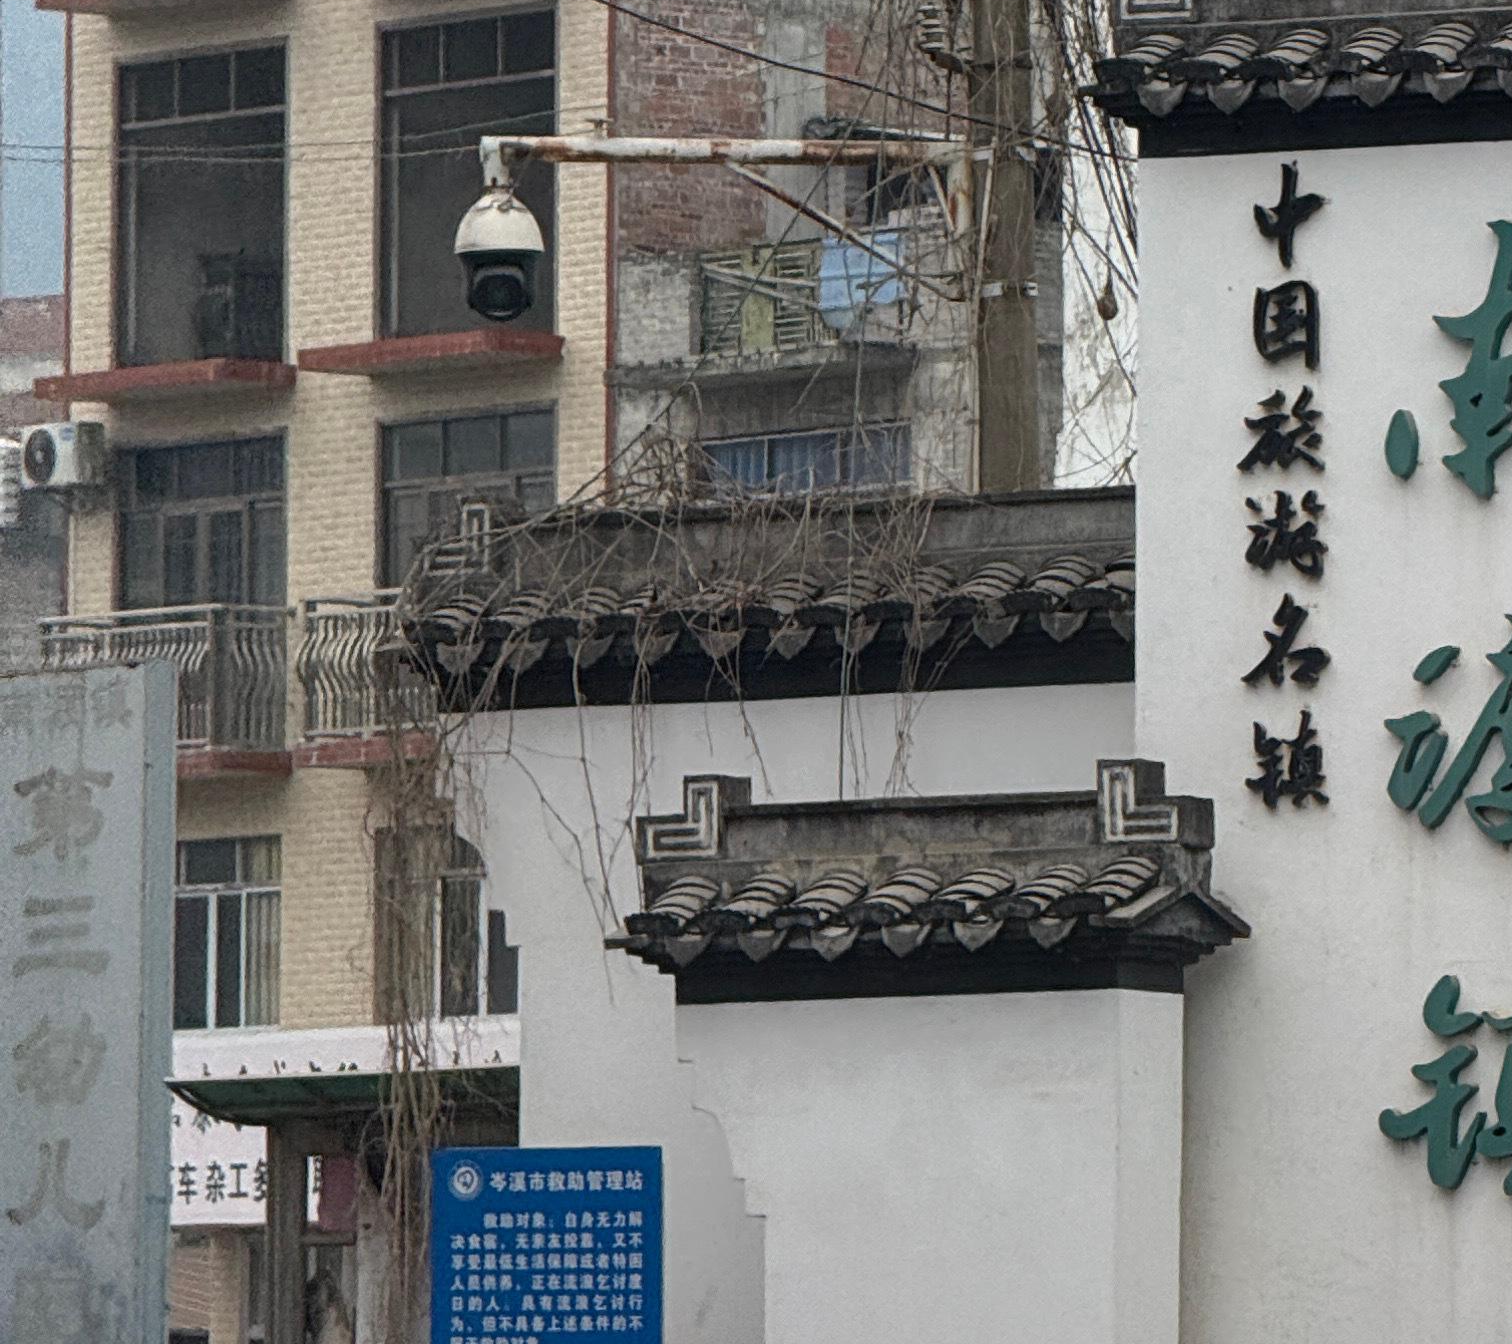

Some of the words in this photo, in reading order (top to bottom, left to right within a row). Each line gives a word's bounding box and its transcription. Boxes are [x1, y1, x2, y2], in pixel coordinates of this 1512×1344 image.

[1236, 159, 1332, 809] 中国旅游名镇
[489, 1170, 643, 1193] 岑溪市救助管理站
